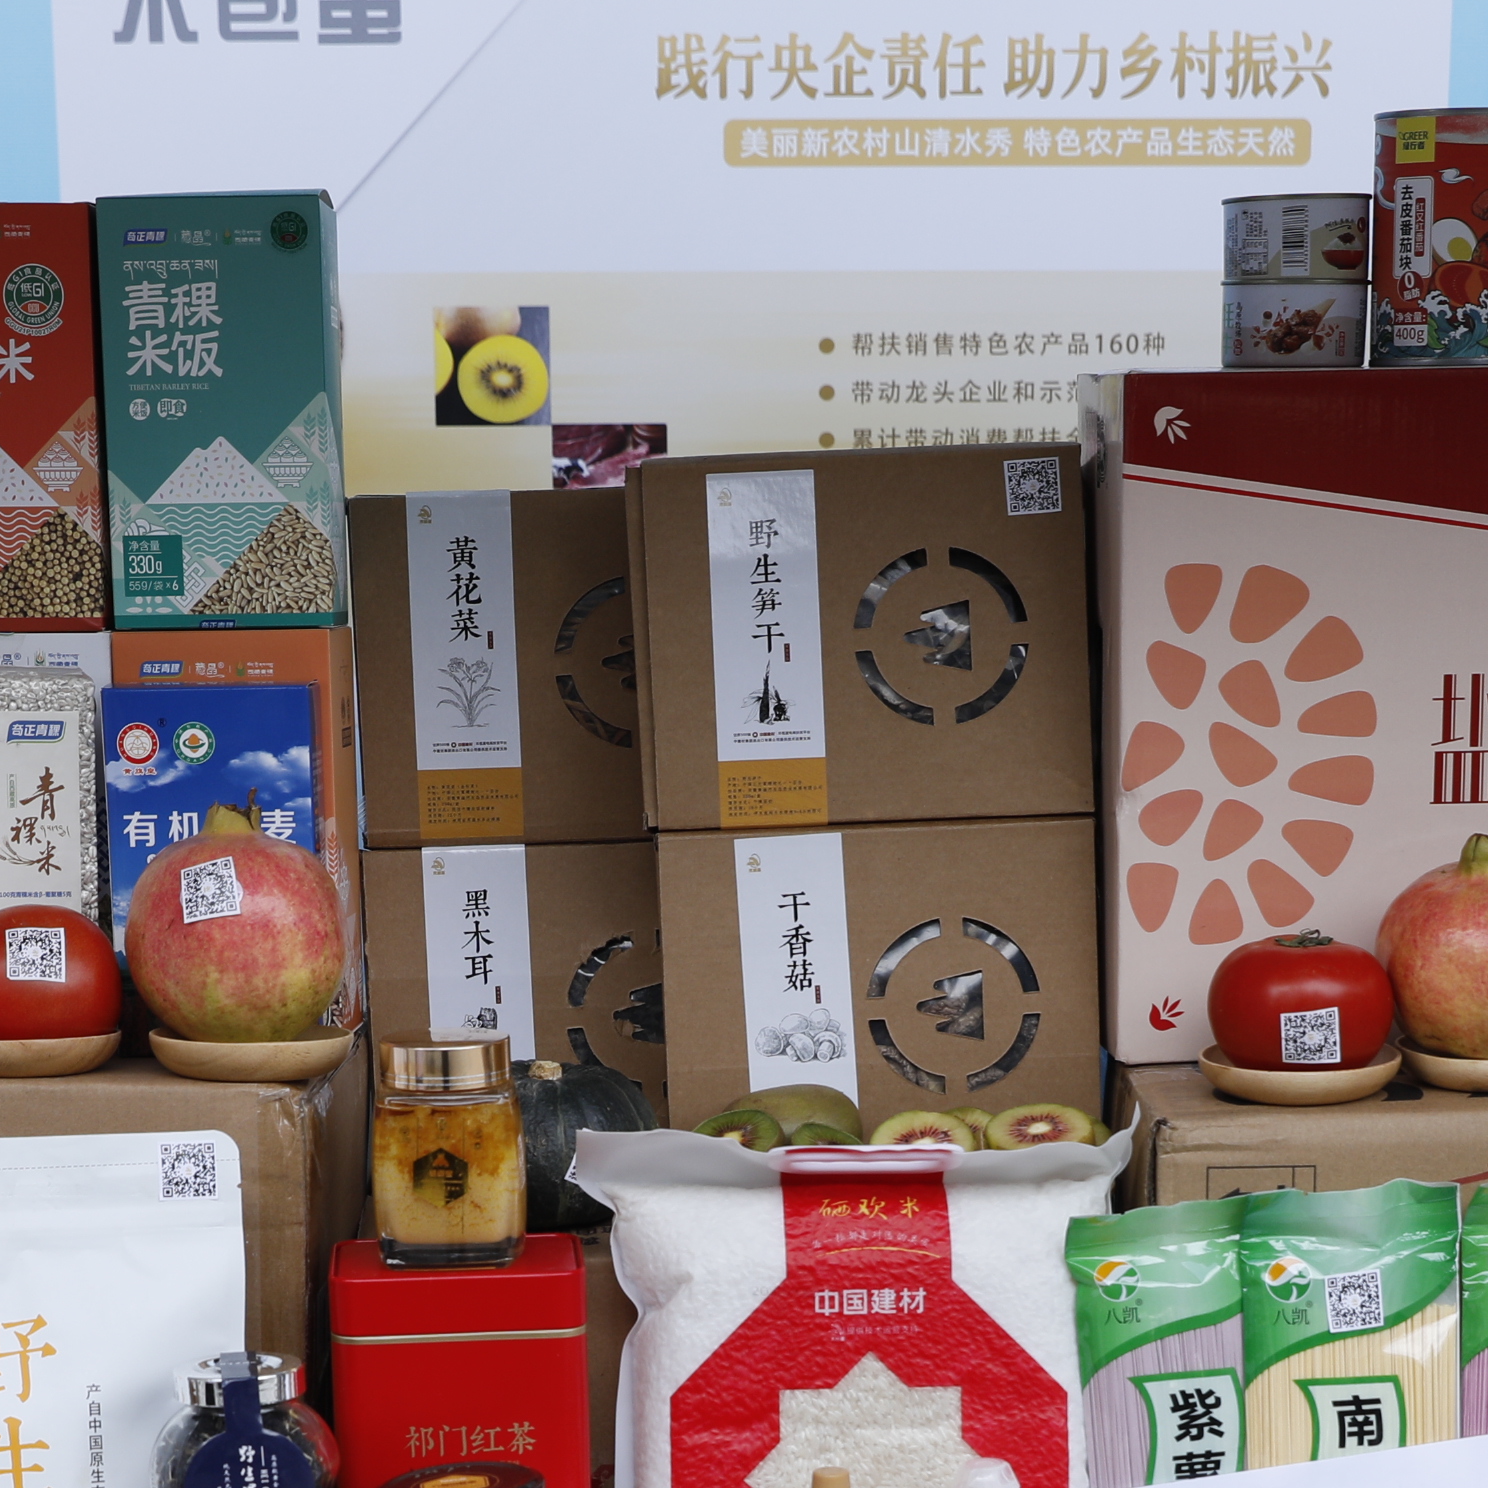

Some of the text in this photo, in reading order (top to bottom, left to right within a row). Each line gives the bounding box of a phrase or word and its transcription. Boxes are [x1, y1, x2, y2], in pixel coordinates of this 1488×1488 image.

[654, 30, 1334, 103] 践行央企责任 助力乡村振兴
[739, 123, 1297, 160] 美丽新农村山清水秀 特色农产品生态天然
[127, 231, 165, 241] 奇正青稞
[1398, 184, 1414, 270] 去皮番茄块
[122, 281, 223, 330] 青稞
[852, 331, 1166, 356] 帮扶销售特色农产品160种
[1395, 328, 1425, 343] 400g
[126, 330, 223, 377] 米饭
[160, 400, 185, 415] 即食
[128, 541, 160, 552] 净含量
[445, 537, 483, 643] 黄花菜
[748, 518, 787, 654] 野生笋干
[143, 663, 180, 674] 奇正青稞
[12, 724, 61, 737] 奇正青稞
[462, 889, 495, 985] 黑木耳
[777, 893, 815, 993] 干香菇
[814, 1287, 927, 1316] 中国建材
[1104, 1302, 1141, 1326] 八凯
[1272, 1302, 1310, 1326] 八凯
[1337, 1395, 1384, 1448] 南
[404, 1423, 537, 1458] 祁门红茶
